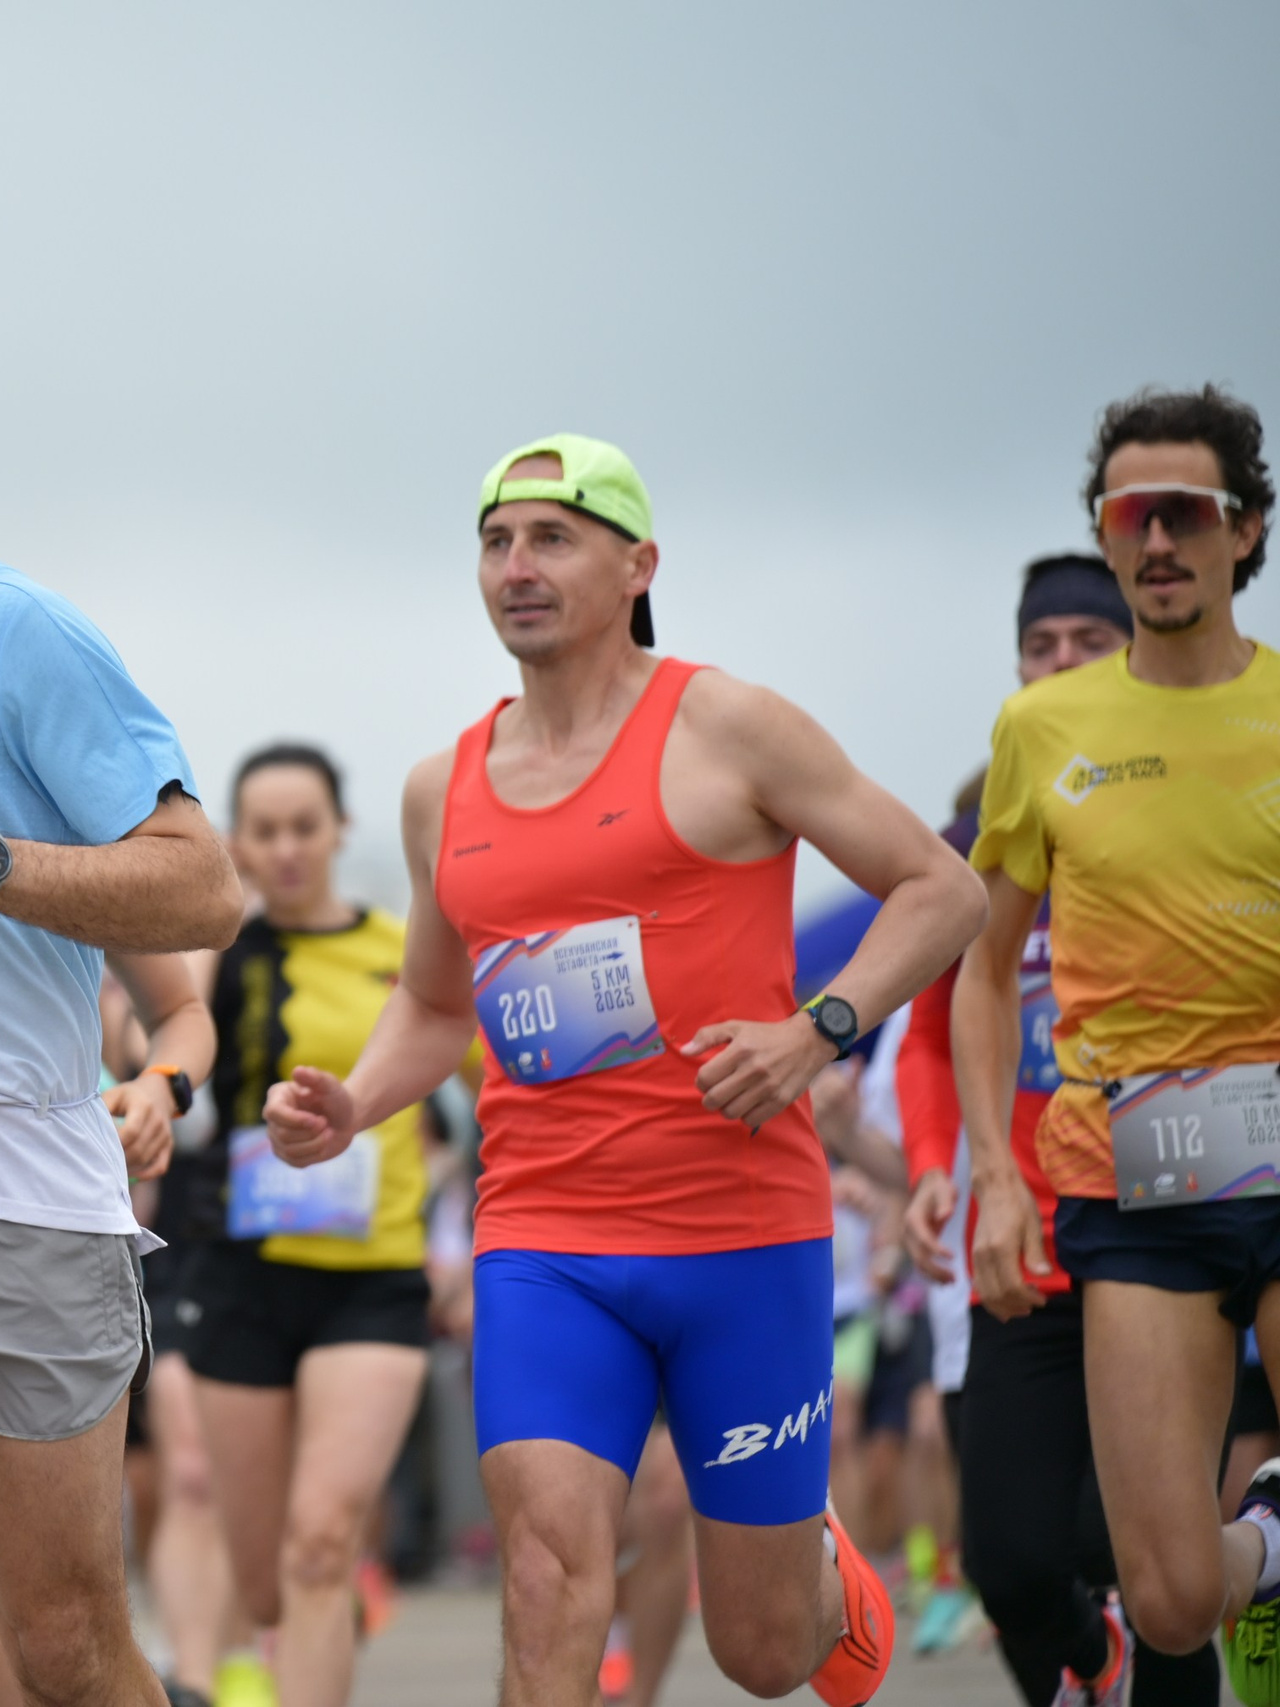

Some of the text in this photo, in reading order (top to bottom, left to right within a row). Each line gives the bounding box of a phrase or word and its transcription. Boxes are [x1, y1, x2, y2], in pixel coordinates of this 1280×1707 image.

[590, 969, 601, 991] 5
[594, 985, 635, 1013] 2025
[498, 984, 557, 1041] 220
[1149, 1113, 1205, 1162] 112
